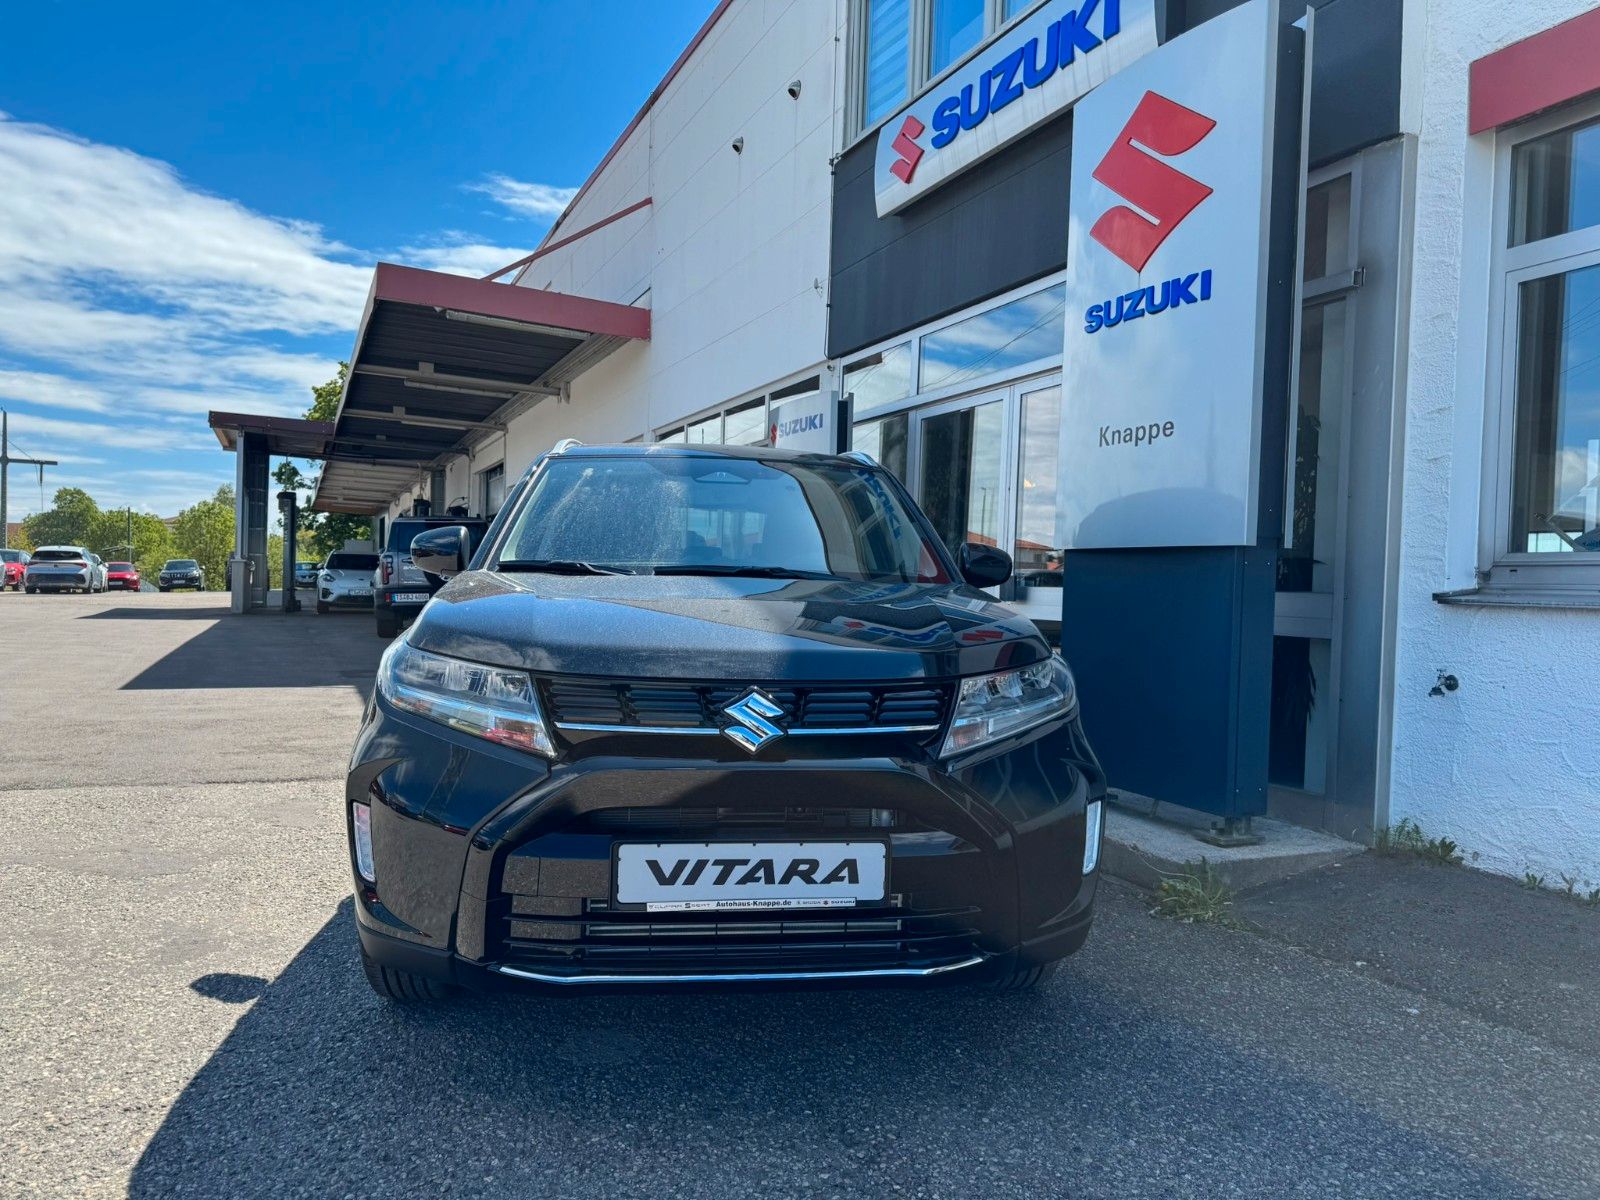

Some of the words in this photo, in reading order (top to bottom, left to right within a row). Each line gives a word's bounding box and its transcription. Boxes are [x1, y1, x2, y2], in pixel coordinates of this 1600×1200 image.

[931, 0, 1120, 149] SUZUKI
[1085, 269, 1212, 334] SUZUKI
[779, 413, 824, 438] SUZUKI
[1099, 421, 1175, 447] Knappe
[646, 858, 859, 886] VITARA
[716, 899, 792, 908] Autohaus-Knappe.de
